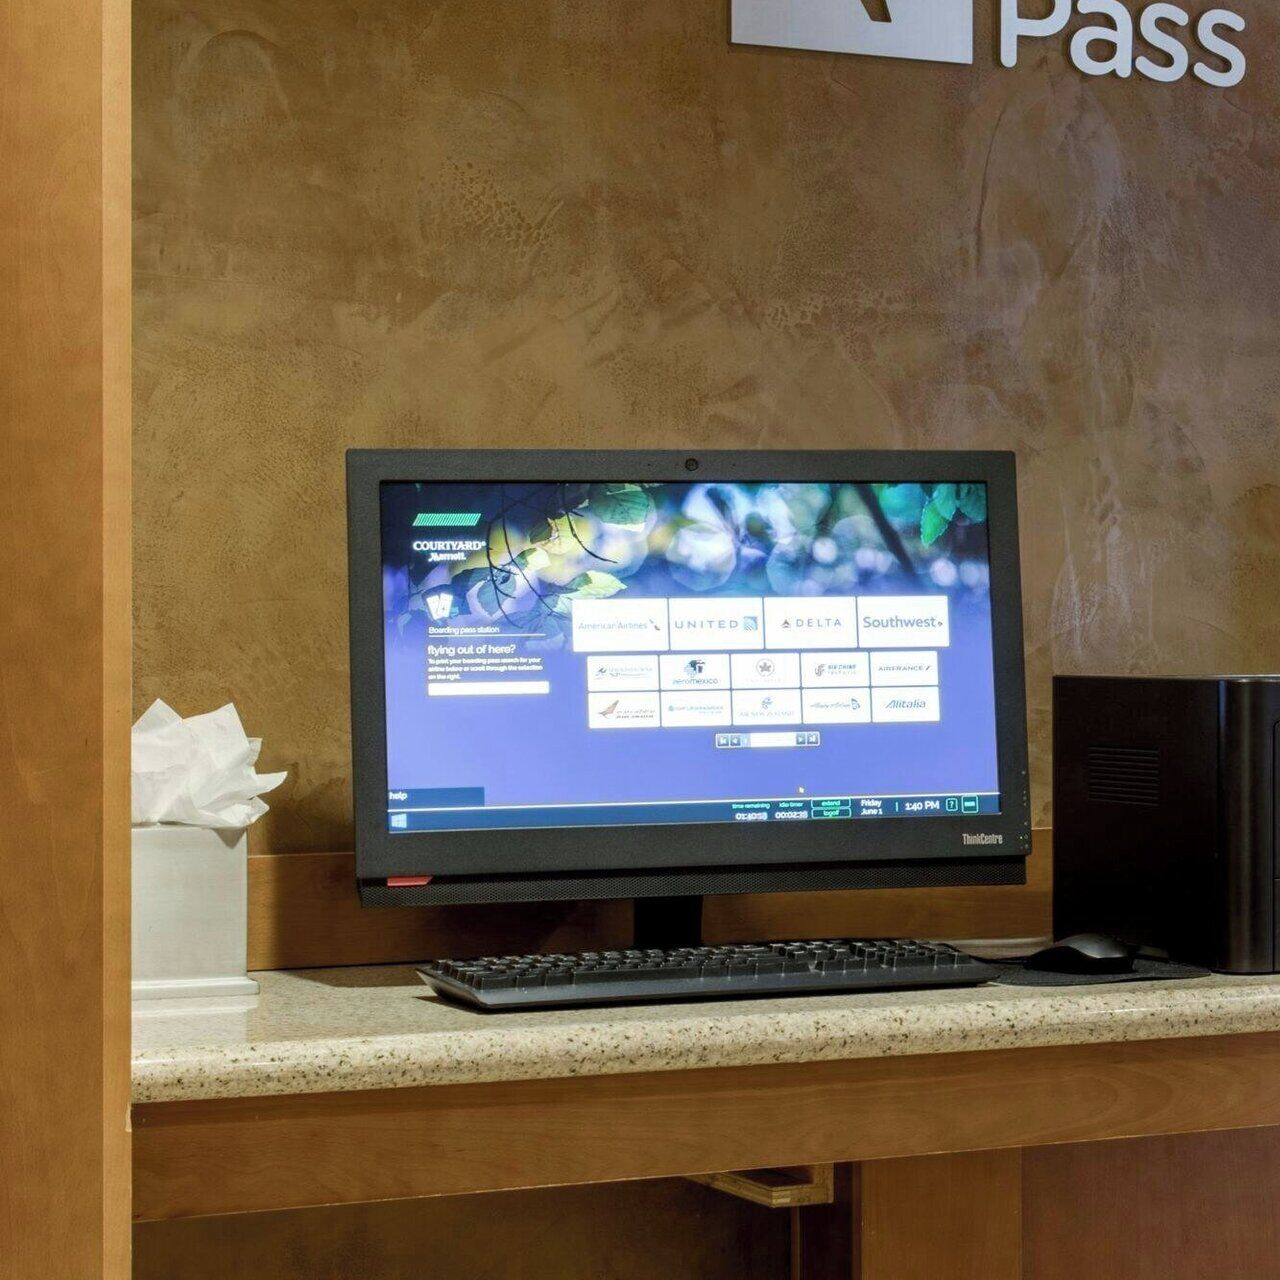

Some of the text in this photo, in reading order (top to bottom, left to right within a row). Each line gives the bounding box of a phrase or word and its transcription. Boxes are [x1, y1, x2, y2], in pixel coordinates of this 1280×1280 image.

[578, 621, 648, 630] American Airlines
[674, 619, 739, 629] UNITED
[796, 618, 842, 628] DELTA
[863, 616, 936, 628] Southwest
[428, 626, 460, 635] Boarding
[460, 627, 476, 635] pass
[428, 644, 516, 656] flying out of here?
[885, 699, 926, 709] Alitalia
[861, 799, 882, 808] Friday
[924, 800, 940, 810] PM
[962, 833, 1004, 846] ThinkCentre
